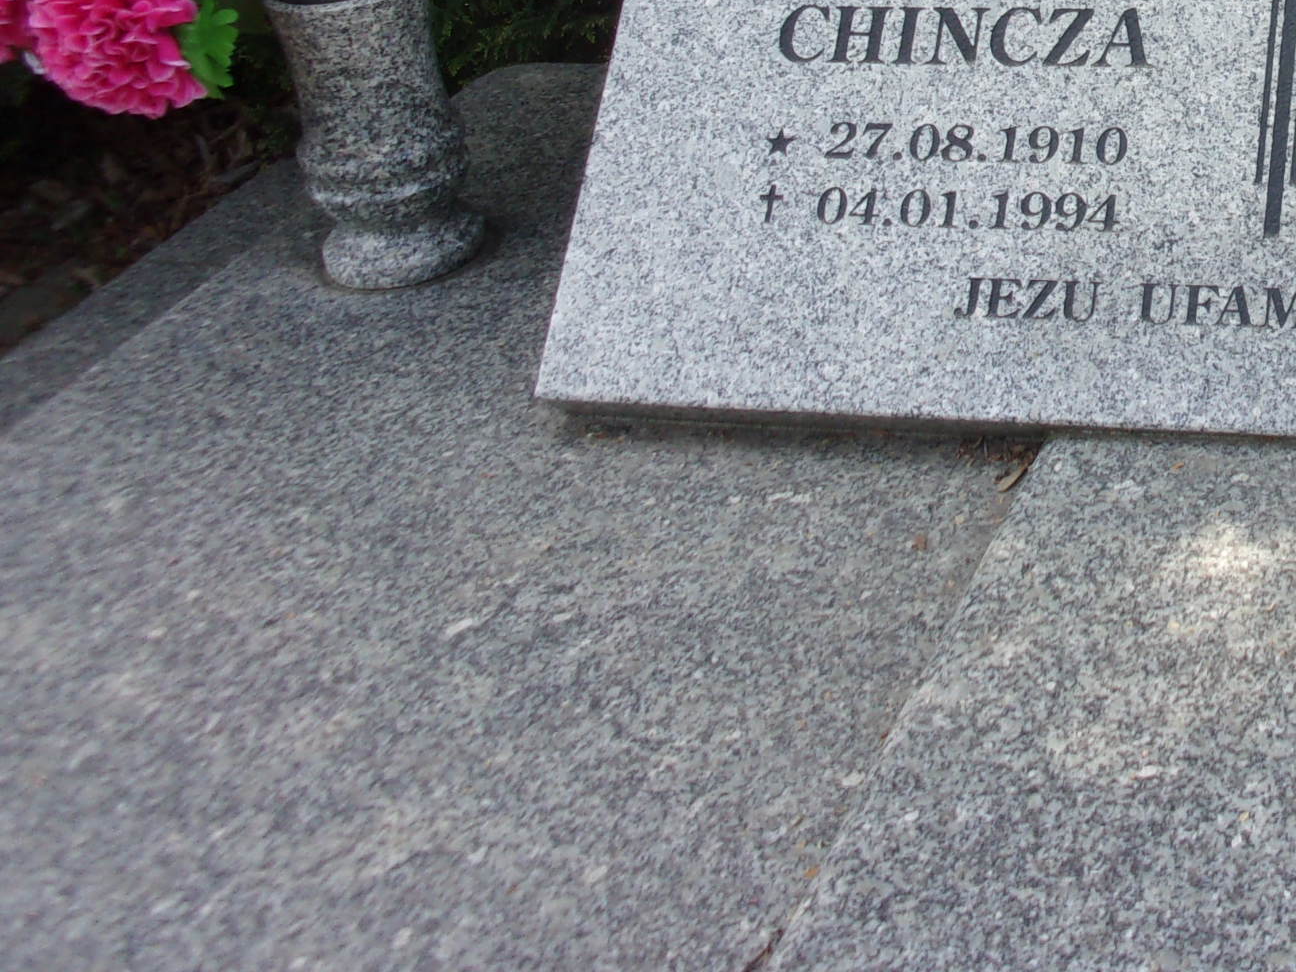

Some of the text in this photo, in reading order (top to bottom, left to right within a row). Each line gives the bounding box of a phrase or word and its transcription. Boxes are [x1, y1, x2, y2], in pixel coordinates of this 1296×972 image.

[778, 4, 1153, 68] CHINCZA
[824, 122, 1128, 166] 27.08.1910
[816, 186, 1120, 230] 04.01.1994
[954, 277, 1100, 323] JEZU
